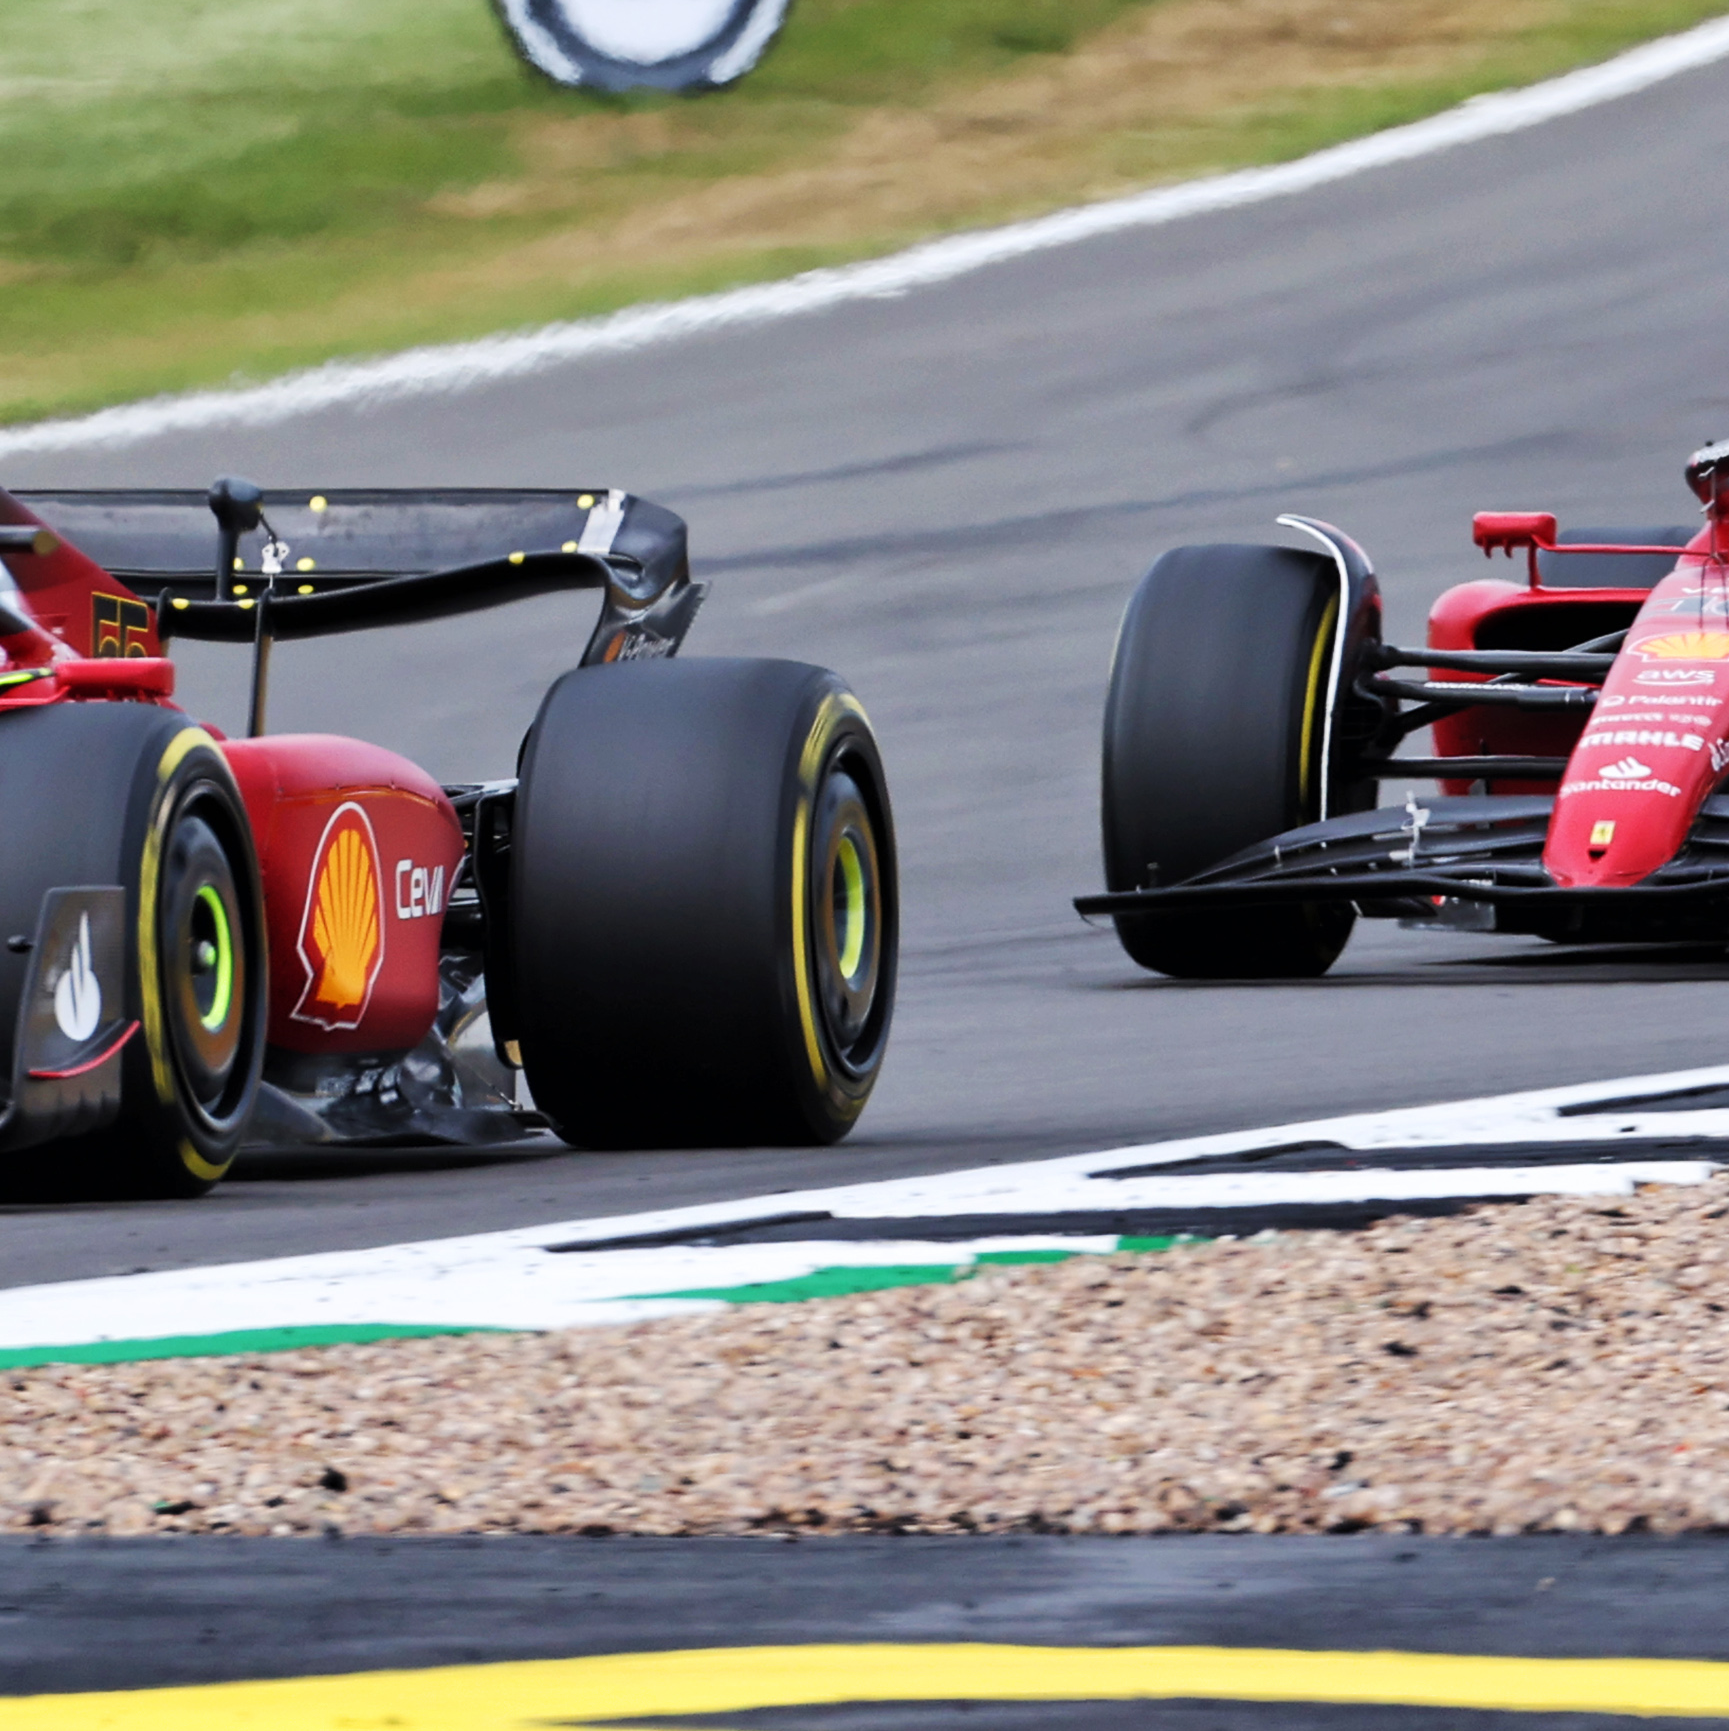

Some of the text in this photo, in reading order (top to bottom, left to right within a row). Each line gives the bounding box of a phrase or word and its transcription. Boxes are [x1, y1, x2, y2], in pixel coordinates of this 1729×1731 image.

[1637, 669, 1716, 681] aws
[1627, 694, 1724, 707] Palantir
[1579, 730, 1705, 752] MAHLE
